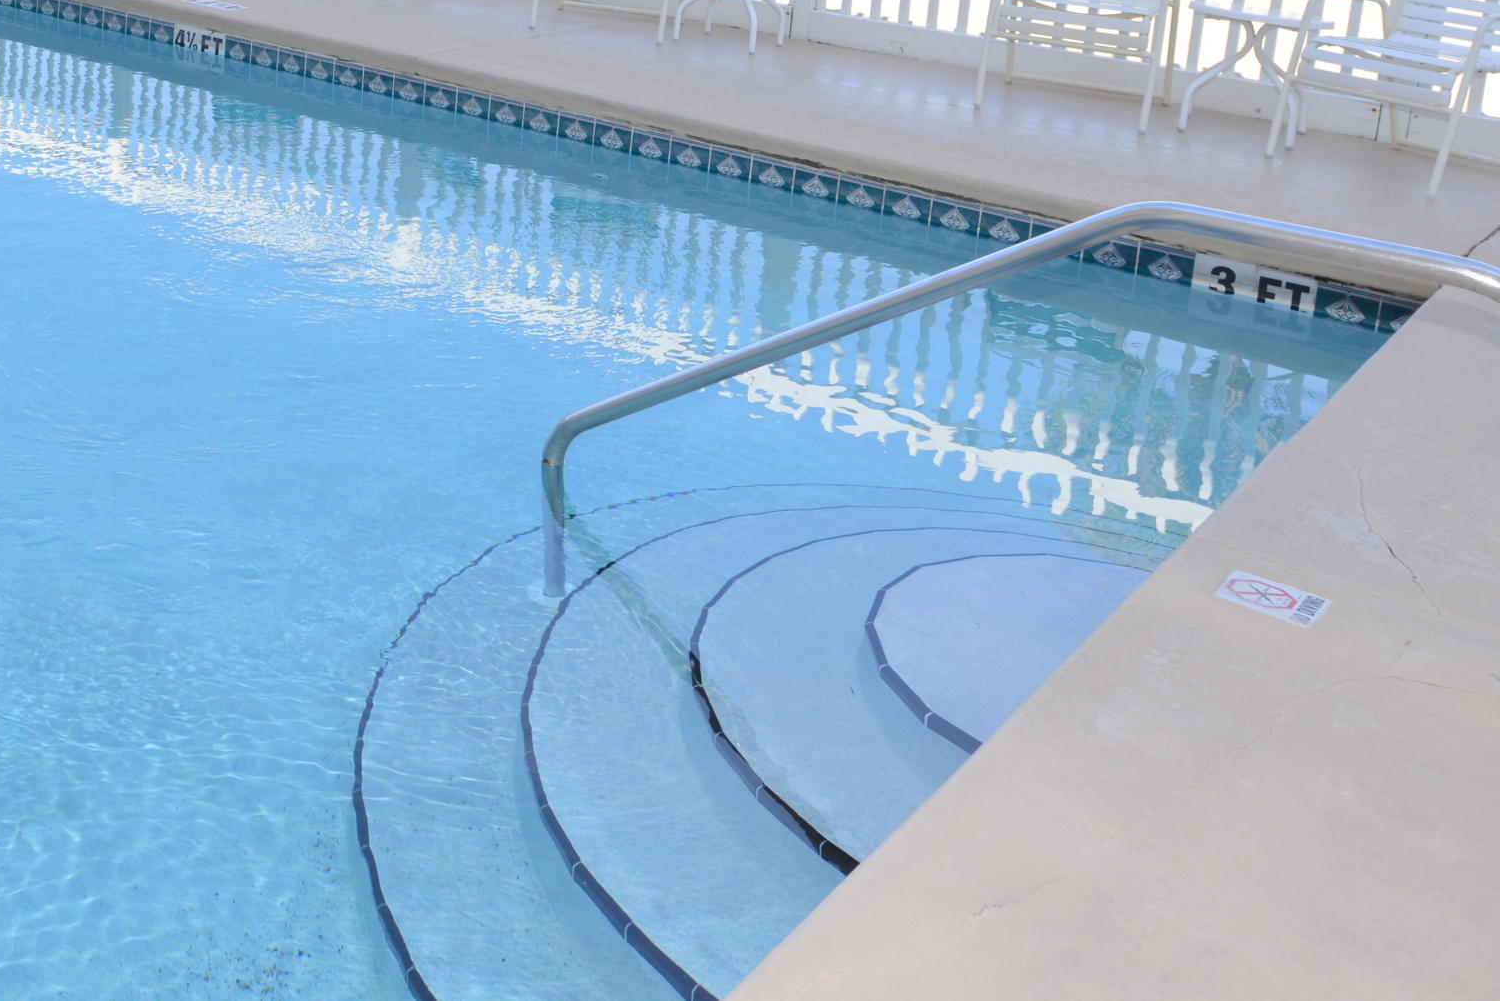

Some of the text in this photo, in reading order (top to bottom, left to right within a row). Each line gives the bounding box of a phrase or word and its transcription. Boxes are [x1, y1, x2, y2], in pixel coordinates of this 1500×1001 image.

[201, 35, 224, 56] FT
[1208, 265, 1311, 311] 3 FT
[1296, 595, 1327, 617] DIVING
